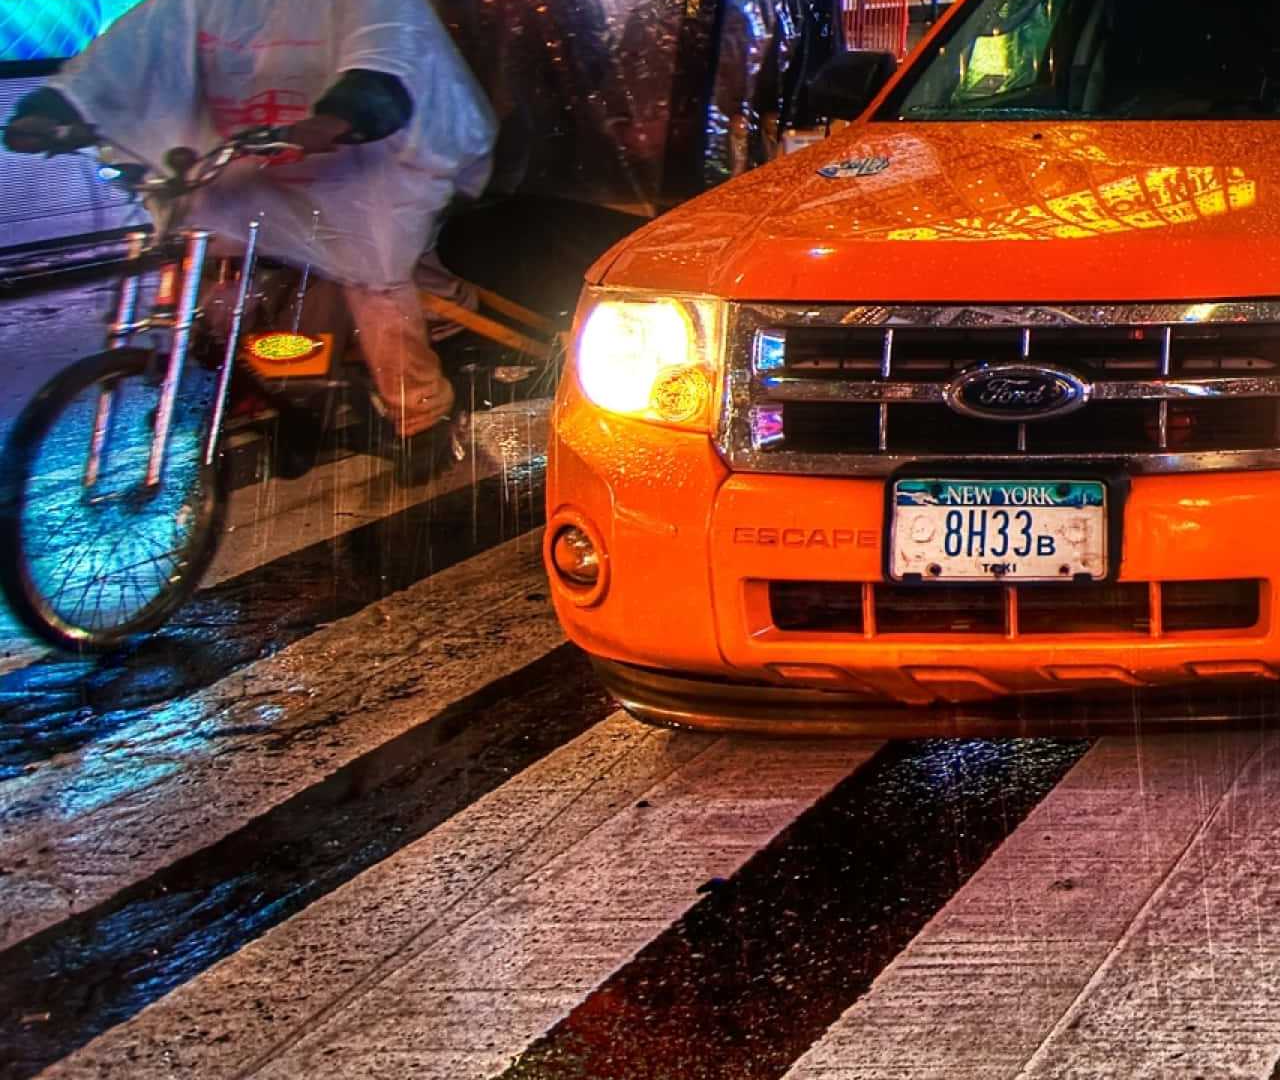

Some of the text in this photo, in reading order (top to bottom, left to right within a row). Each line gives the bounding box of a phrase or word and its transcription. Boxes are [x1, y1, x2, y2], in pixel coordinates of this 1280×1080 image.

[979, 378, 1047, 403] Ford
[946, 486, 1056, 506] NEW YORK
[733, 526, 880, 549] ESCAPE
